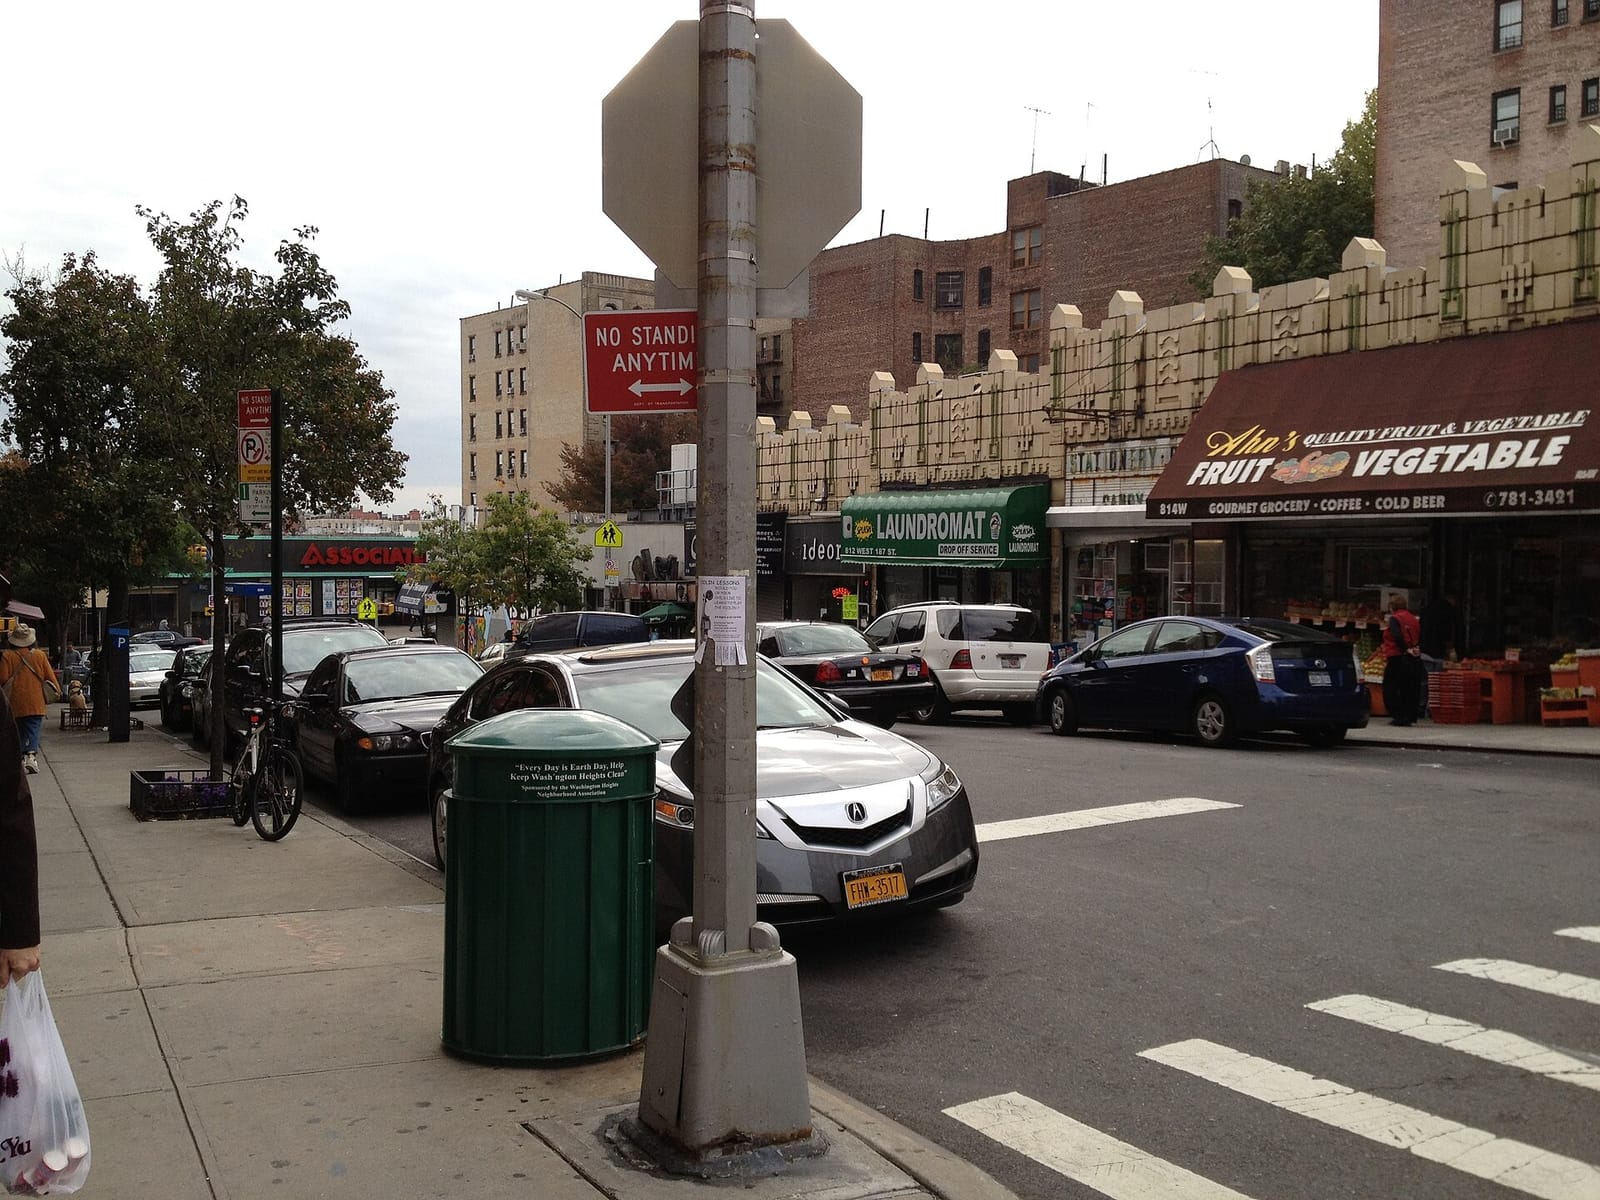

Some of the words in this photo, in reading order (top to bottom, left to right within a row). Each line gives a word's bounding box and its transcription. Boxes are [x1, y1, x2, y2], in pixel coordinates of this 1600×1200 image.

[595, 327, 620, 347] NO
[612, 352, 694, 372] ANYTIM
[1206, 424, 1300, 457] Ahn's
[1303, 428, 1382, 447] QUALITY
[1380, 423, 1440, 439] FRUIT
[1440, 422, 1457, 435] &
[1463, 410, 1590, 434] VEGETABLE
[1069, 447, 1157, 475] STATIONERY
[1186, 458, 1276, 486] FRUIT
[1352, 435, 1571, 477] VEGETABLE
[1159, 503, 1187, 515] 814W
[1209, 502, 1257, 514] GOURMET
[1260, 500, 1310, 514] GROCERY
[1320, 498, 1362, 511] COFFEE
[1375, 497, 1410, 510] COLD
[1413, 495, 1445, 509] BEER
[876, 511, 986, 540] LAUNDROMAT
[857, 547, 873, 555] WEST
[940, 545, 955, 555] DROP
[958, 544, 968, 554] OFF
[970, 543, 998, 555] SERVICE
[1008, 542, 1039, 553] LAUNDROMAT
[118, 637, 126, 648] P
[544, 764, 560, 772] Day
[561, 763, 568, 771] is
[570, 763, 592, 771] Earth
[610, 761, 625, 770] Help
[510, 773, 529, 782] Keep
[579, 771, 606, 780] Heights
[569, 783, 601, 791] Washington
